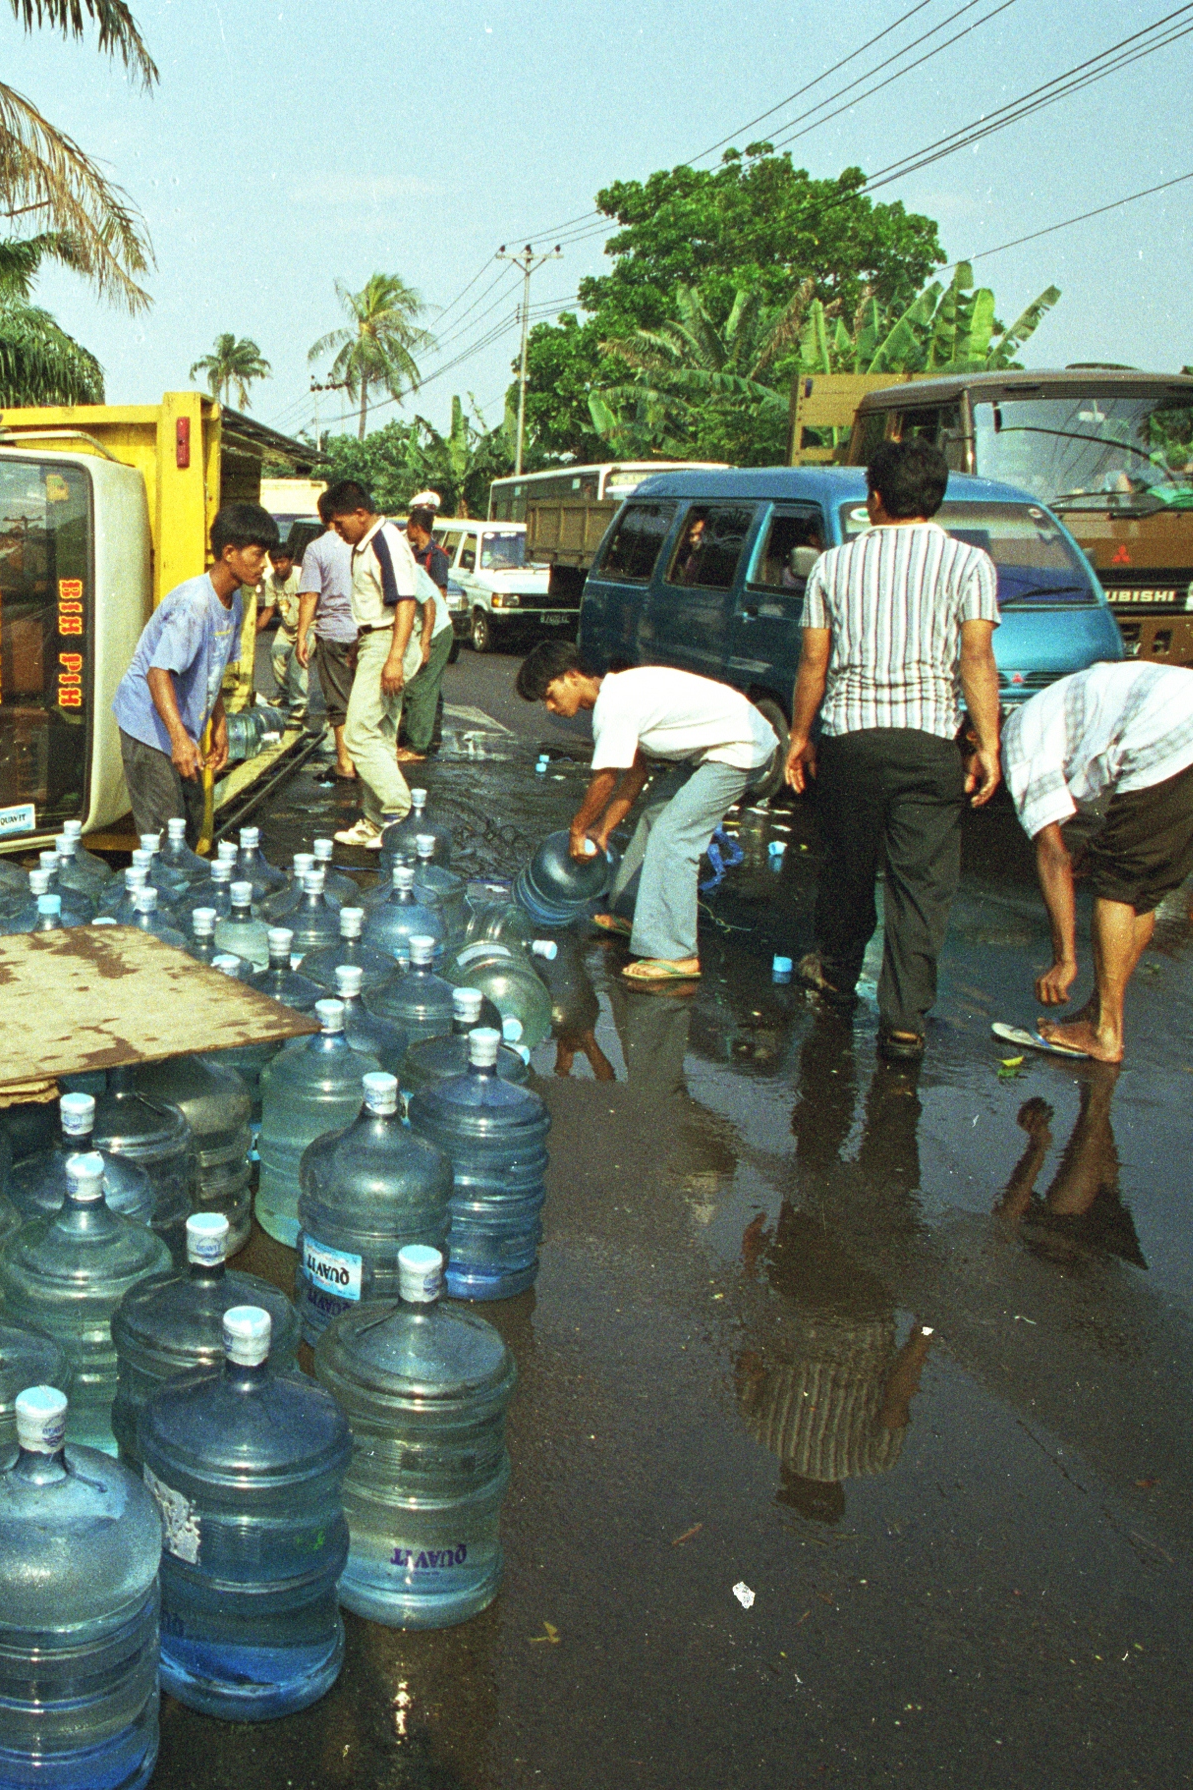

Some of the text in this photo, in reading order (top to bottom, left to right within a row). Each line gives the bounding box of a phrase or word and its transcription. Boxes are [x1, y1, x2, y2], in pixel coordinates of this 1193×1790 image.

[0, 813, 26, 826] QUAVIT
[307, 1253, 350, 1286] QUAVIT
[390, 1543, 467, 1569] QUAVIT
